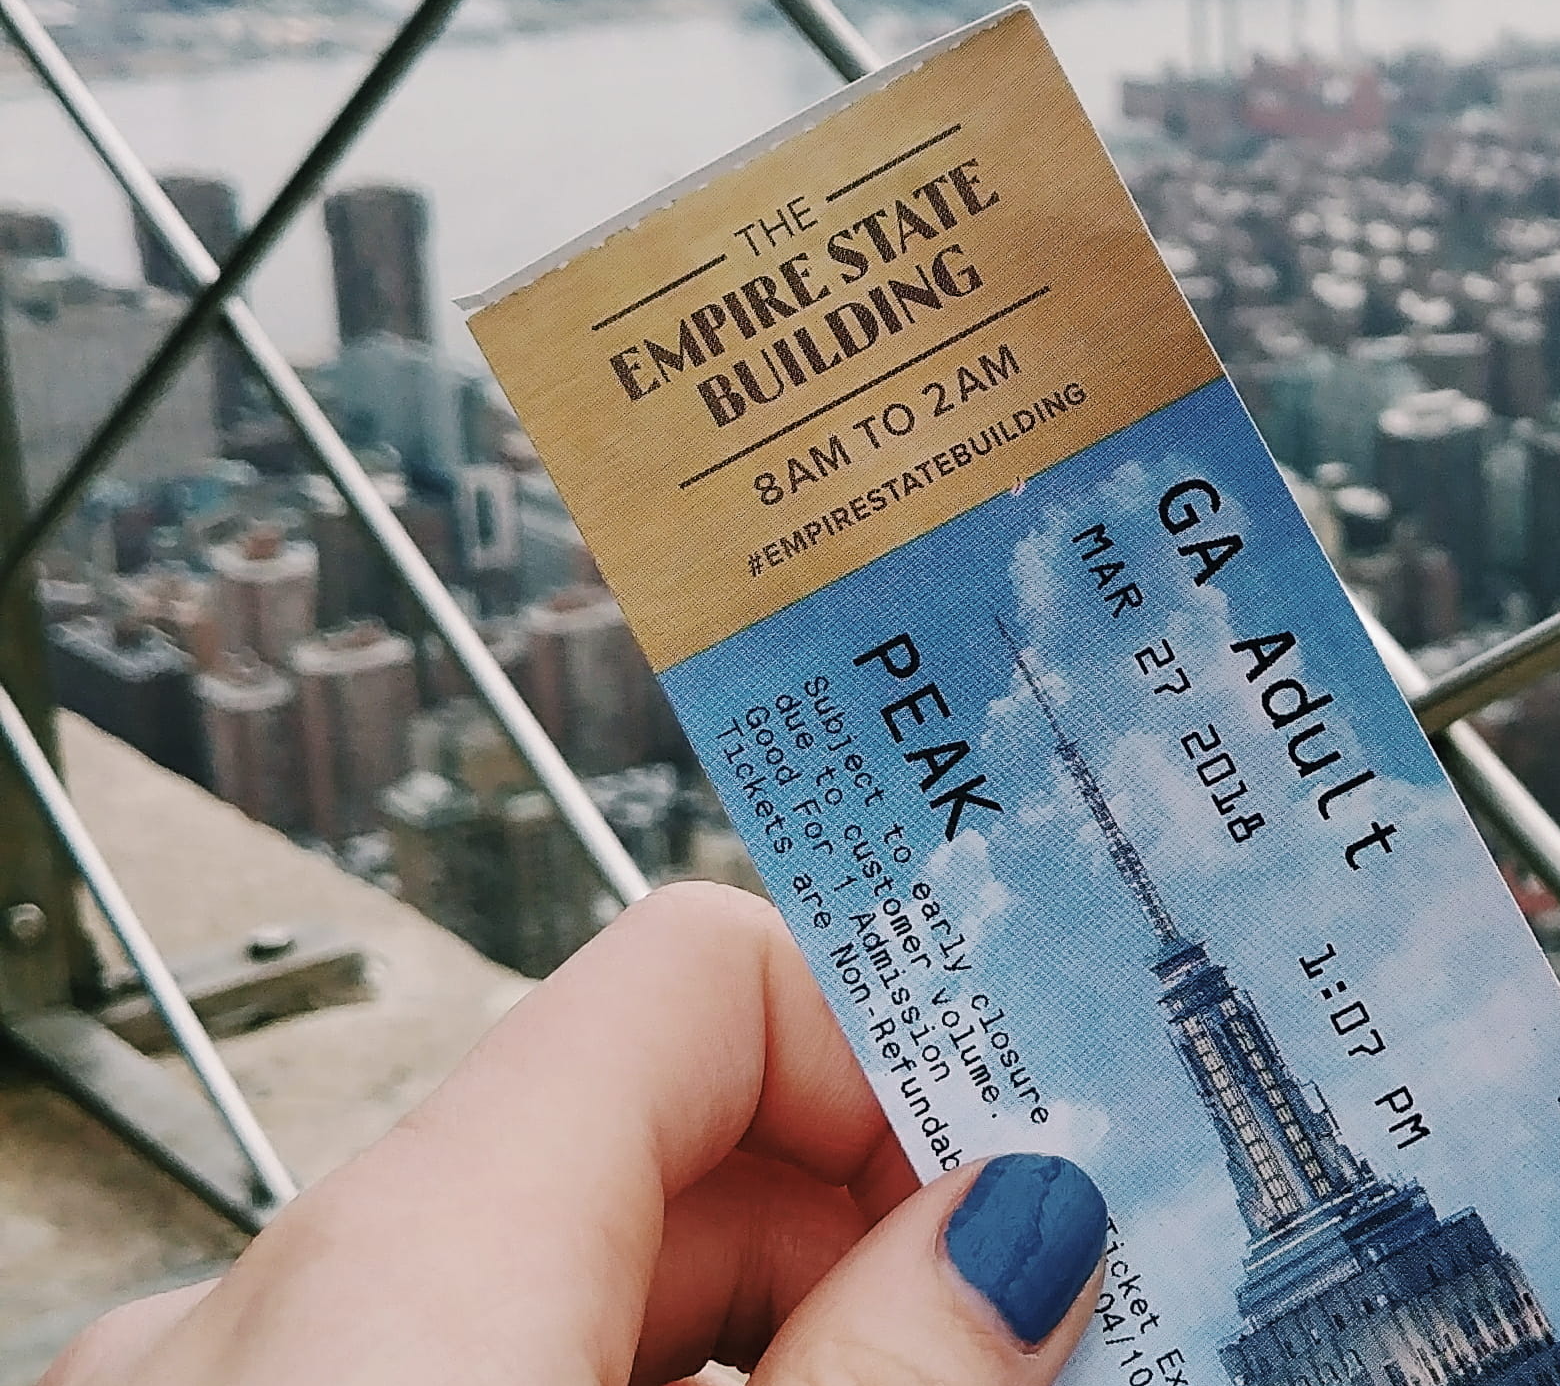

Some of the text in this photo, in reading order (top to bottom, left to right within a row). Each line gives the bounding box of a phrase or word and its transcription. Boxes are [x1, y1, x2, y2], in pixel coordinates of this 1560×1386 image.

[610, 158, 1001, 402] EMPIRE STATE
[695, 243, 984, 428] BUILDING
[734, 196, 818, 257] THE
[747, 382, 1088, 579] #EMPIRESTATEBUILDING
[754, 343, 1022, 507] 8AM TO 2AM
[852, 632, 1003, 843] PEAK
[1158, 478, 1398, 871] GA Adult
[717, 717, 962, 1173] Tickets are Non-Refundab
[745, 706, 952, 1084] Good For 1 Admission
[775, 694, 1001, 1120] due to customer volume.
[803, 676, 1050, 1126] Subject to early closure
[1072, 523, 1431, 1150] MAR 27 2018 1:07 PM
[1102, 1216, 1161, 1334] Ticket
